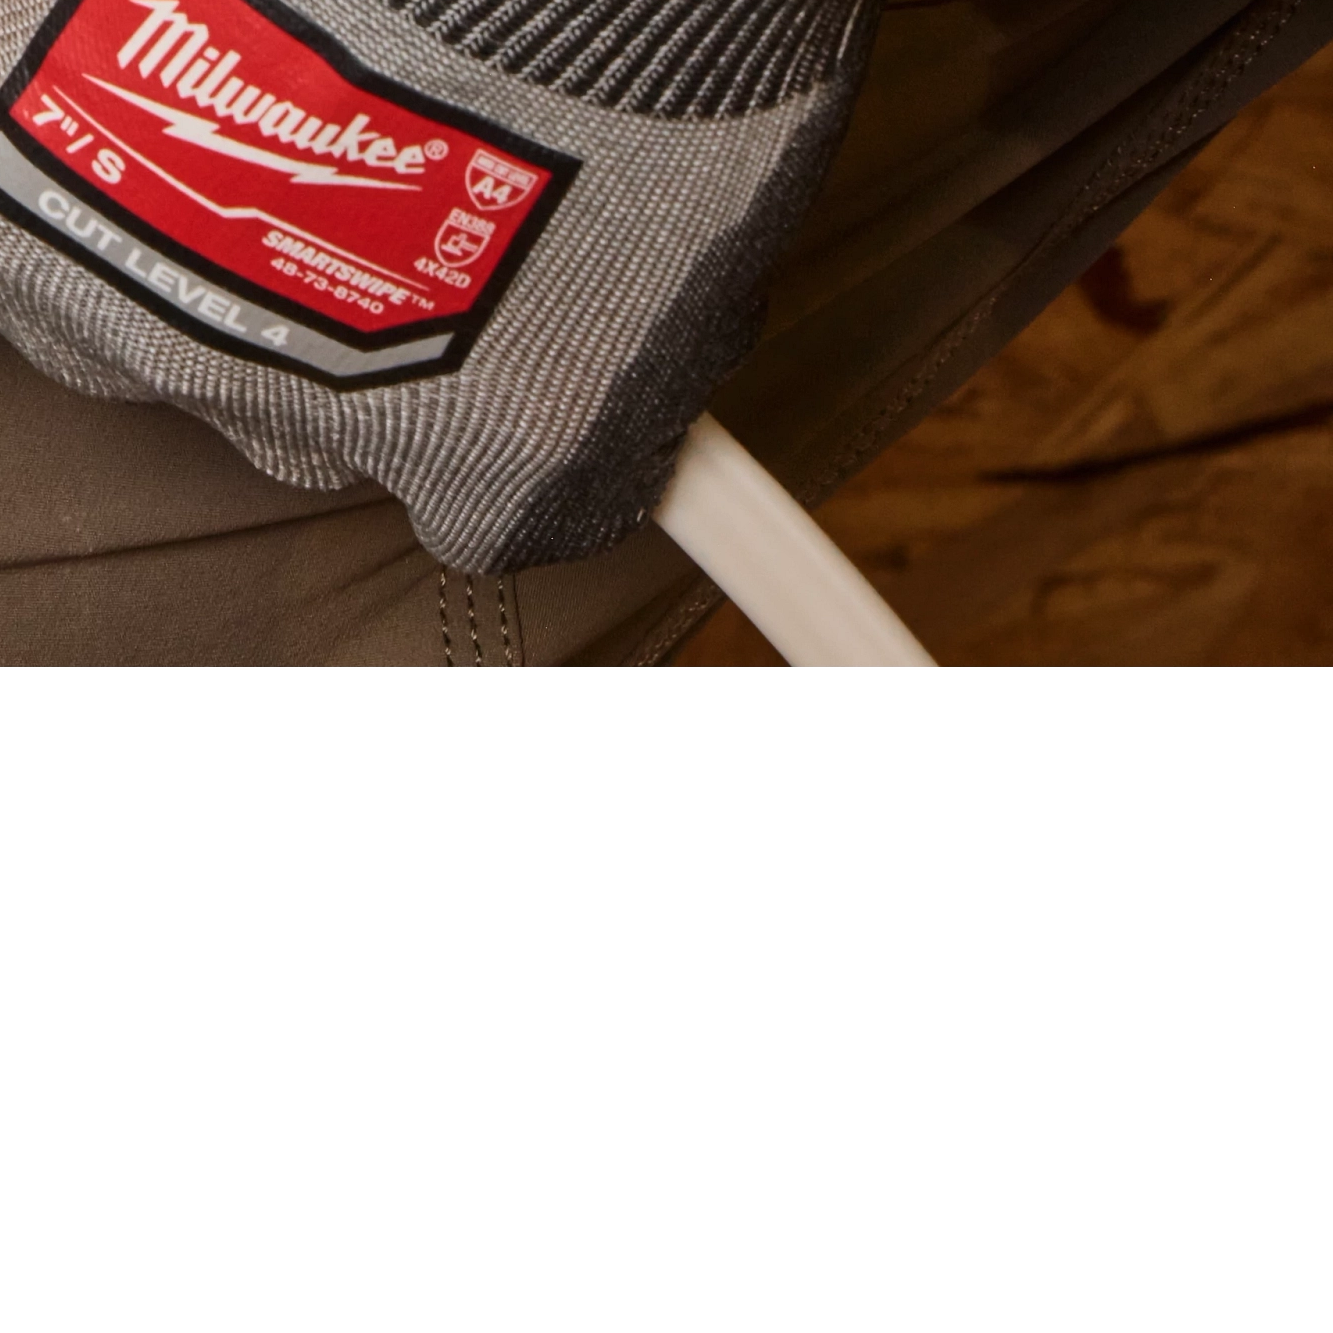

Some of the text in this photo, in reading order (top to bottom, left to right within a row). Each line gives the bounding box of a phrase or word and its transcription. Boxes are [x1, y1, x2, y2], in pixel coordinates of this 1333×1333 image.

[472, 177, 511, 205] A4
[38, 190, 288, 346] CUT LEVEL 4
[271, 258, 384, 314] 48-73-8740
[414, 257, 471, 288] 4X42D
